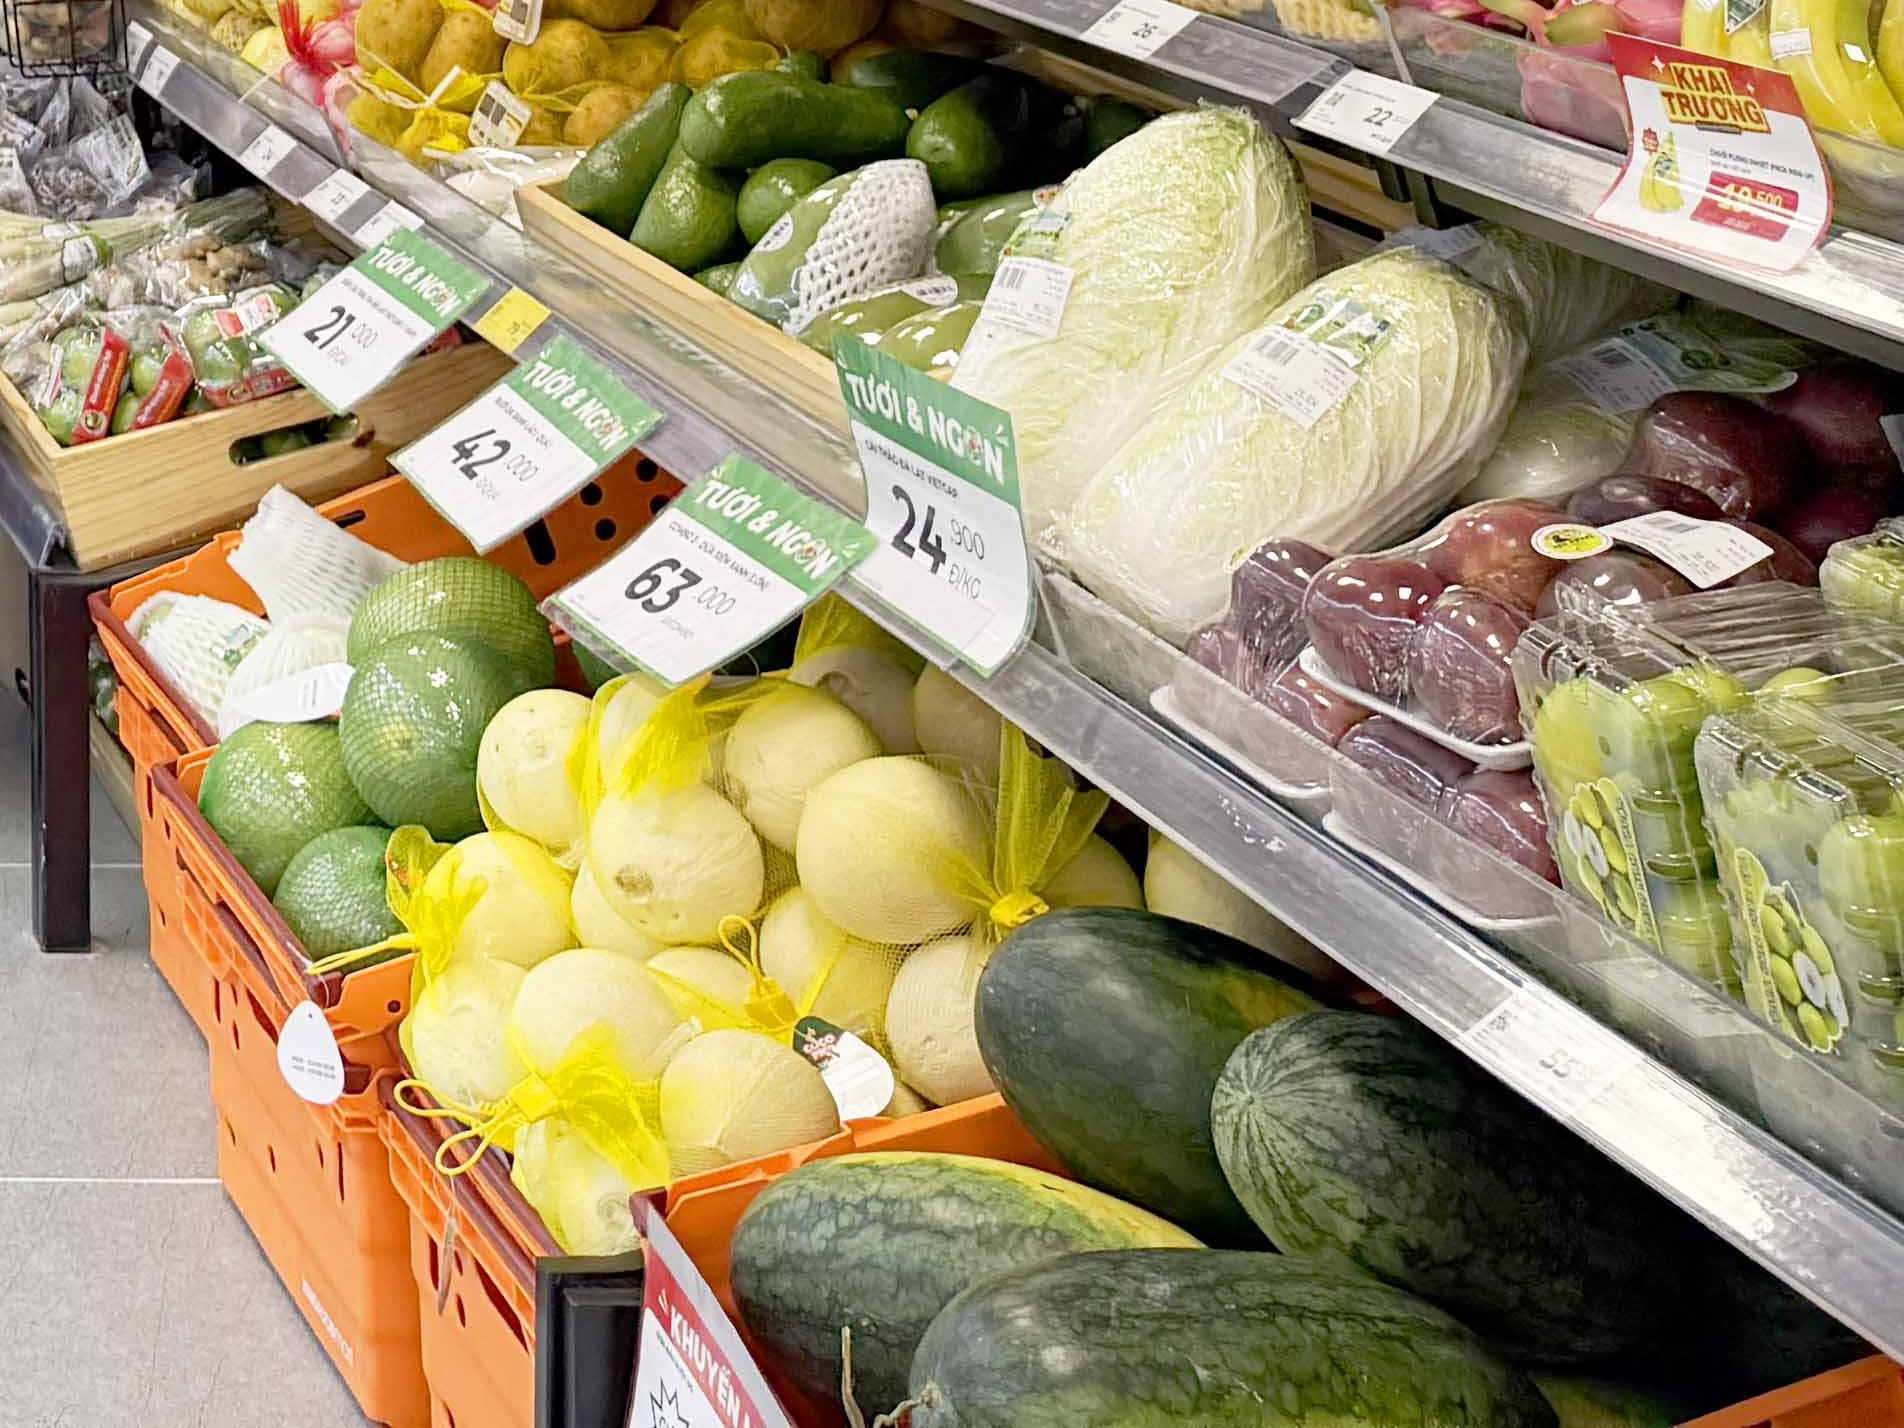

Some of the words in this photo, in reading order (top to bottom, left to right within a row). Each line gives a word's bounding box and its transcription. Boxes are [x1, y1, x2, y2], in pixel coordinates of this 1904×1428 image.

[1672, 66, 1729, 95] KHAI
[1363, 106, 1394, 127] 22
[367, 246, 417, 279] TƯƠI
[402, 266, 426, 285] &
[522, 360, 578, 397] TƯƠI
[560, 387, 588, 410] &
[845, 371, 903, 426] TƯƠI
[905, 395, 926, 437] &
[927, 404, 1007, 486] NGON
[695, 478, 762, 523] TƯƠI
[747, 510, 777, 536] &
